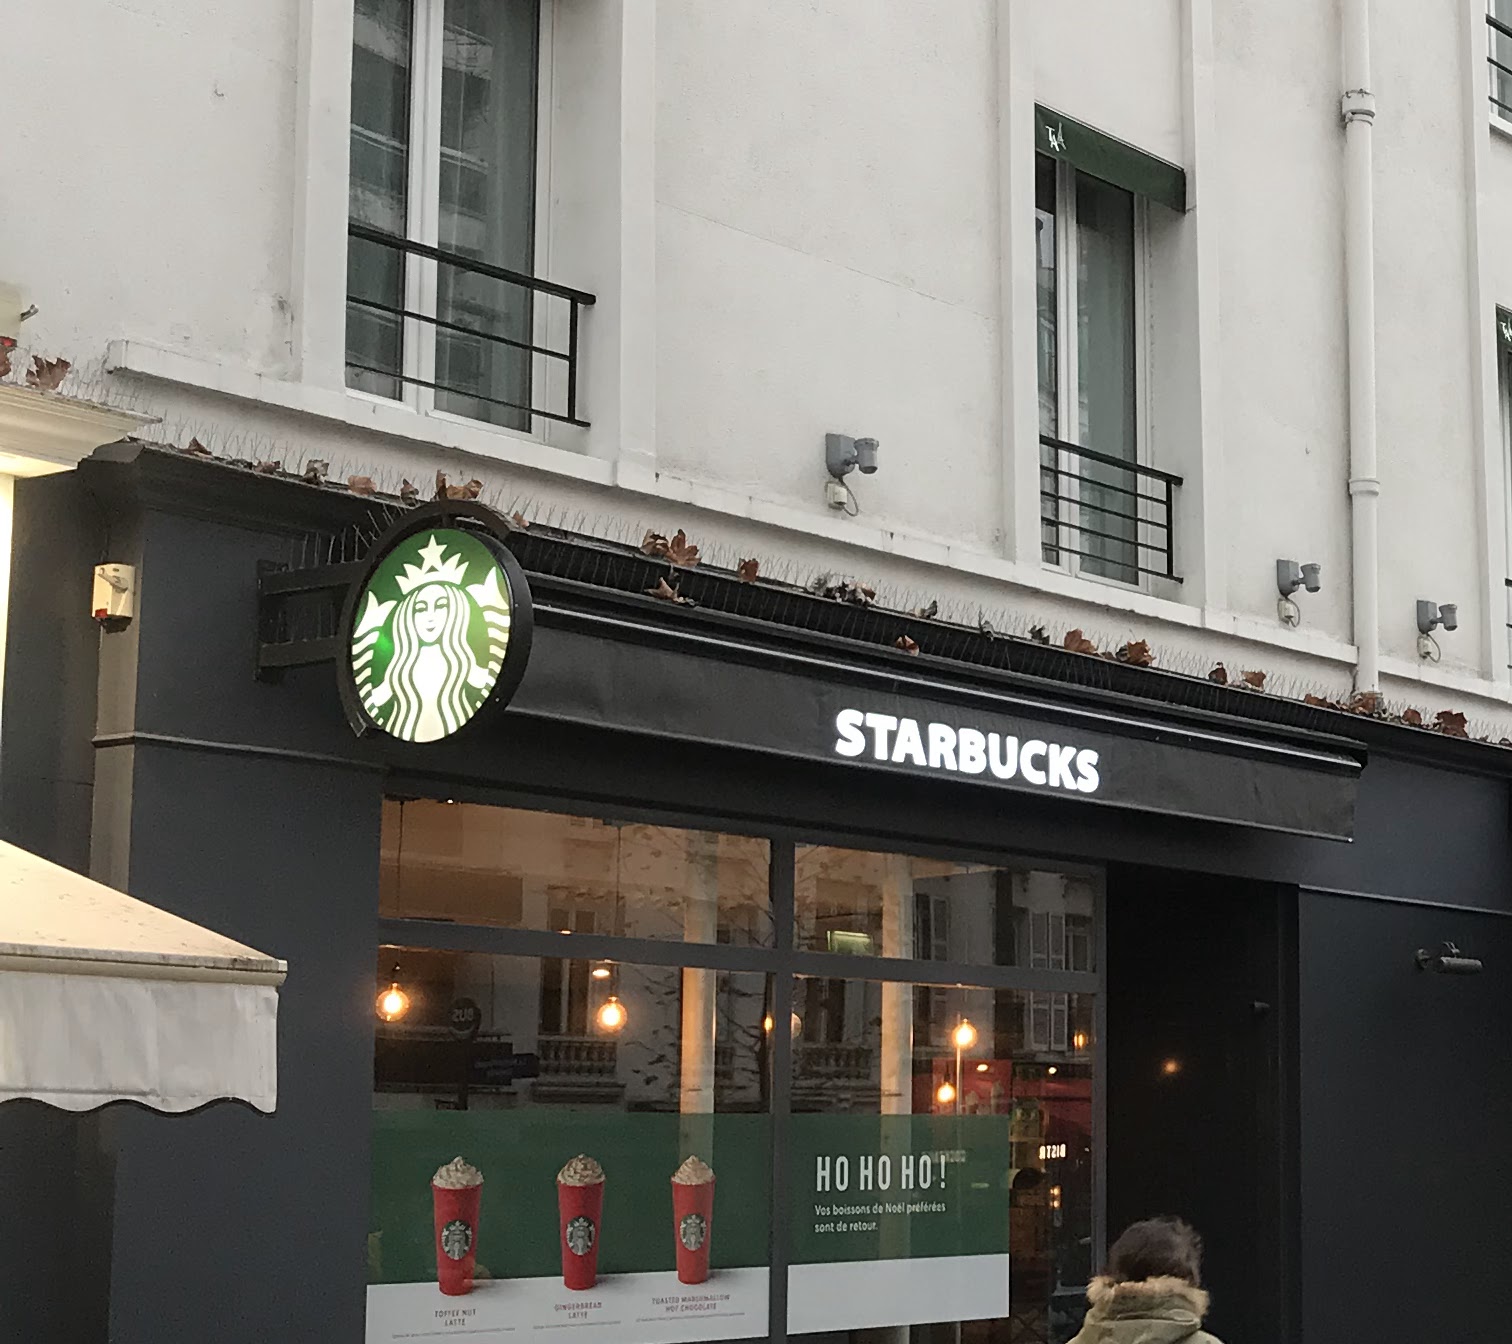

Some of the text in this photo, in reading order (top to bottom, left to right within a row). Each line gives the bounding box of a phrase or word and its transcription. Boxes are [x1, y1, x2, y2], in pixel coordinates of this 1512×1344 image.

[835, 709, 1100, 793] STARBUCKS
[816, 1156, 849, 1192] HO
[859, 1155, 891, 1191] HO
[815, 1205, 830, 1216] Vos
[833, 1204, 871, 1215] boissons
[872, 1203, 883, 1214] de
[815, 1222, 835, 1233] sont
[836, 1221, 848, 1232] de
